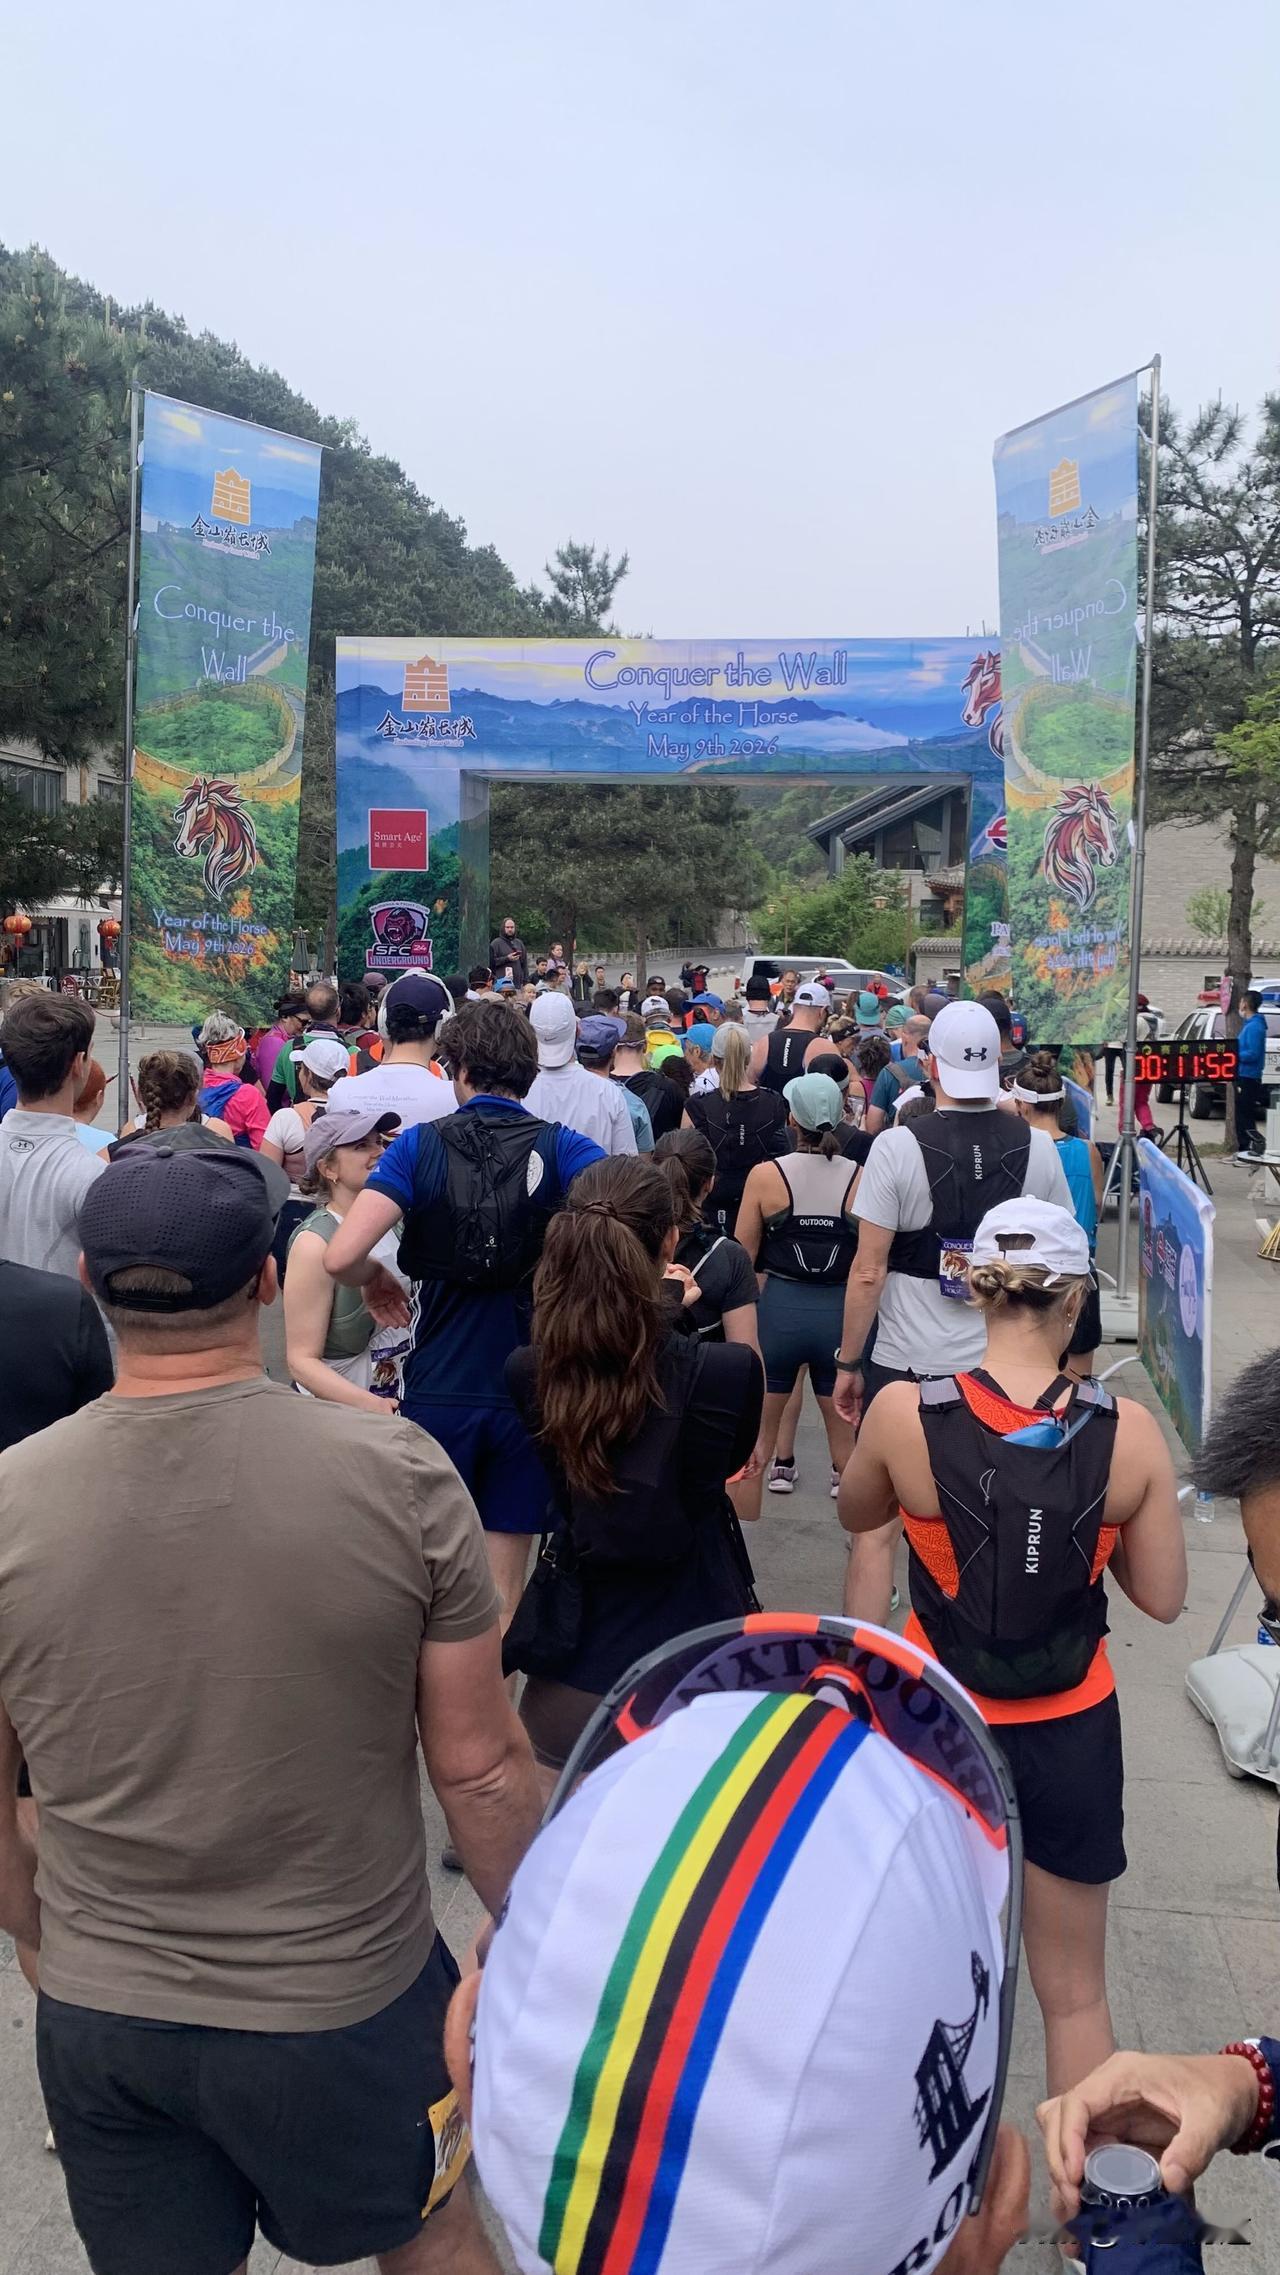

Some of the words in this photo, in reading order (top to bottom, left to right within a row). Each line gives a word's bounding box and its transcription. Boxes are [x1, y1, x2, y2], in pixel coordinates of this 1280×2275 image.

[154, 585, 257, 639] Conquer
[262, 611, 296, 642] the
[201, 646, 247, 683] Wall
[584, 650, 720, 700] Conquer
[724, 652, 772, 686] the
[778, 650, 848, 691] Wall
[628, 701, 677, 727] Year
[679, 702, 701, 724] of
[704, 703, 733, 724] the
[738, 702, 799, 727] Horse
[647, 733, 691, 762] May
[696, 733, 726, 757] 9th
[729, 736, 780, 756] 2026
[374, 831, 401, 841] Smart
[403, 831, 422, 844] Age
[152, 908, 190, 928] Year
[192, 911, 210, 930] of
[211, 912, 229, 932] the
[230, 915, 268, 935] Horse
[165, 931, 200, 957] May
[205, 937, 225, 954] 9th
[226, 941, 255, 955] 2026
[375, 945, 411, 956] SFC
[370, 956, 430, 966] UNDERGROUND
[1134, 1053, 1236, 1081] 00:11:52
[973, 1144, 983, 1180] KIPRUN
[799, 1218, 834, 1228] OUTDOOR
[1025, 1508, 1043, 1574] KIPRUN
